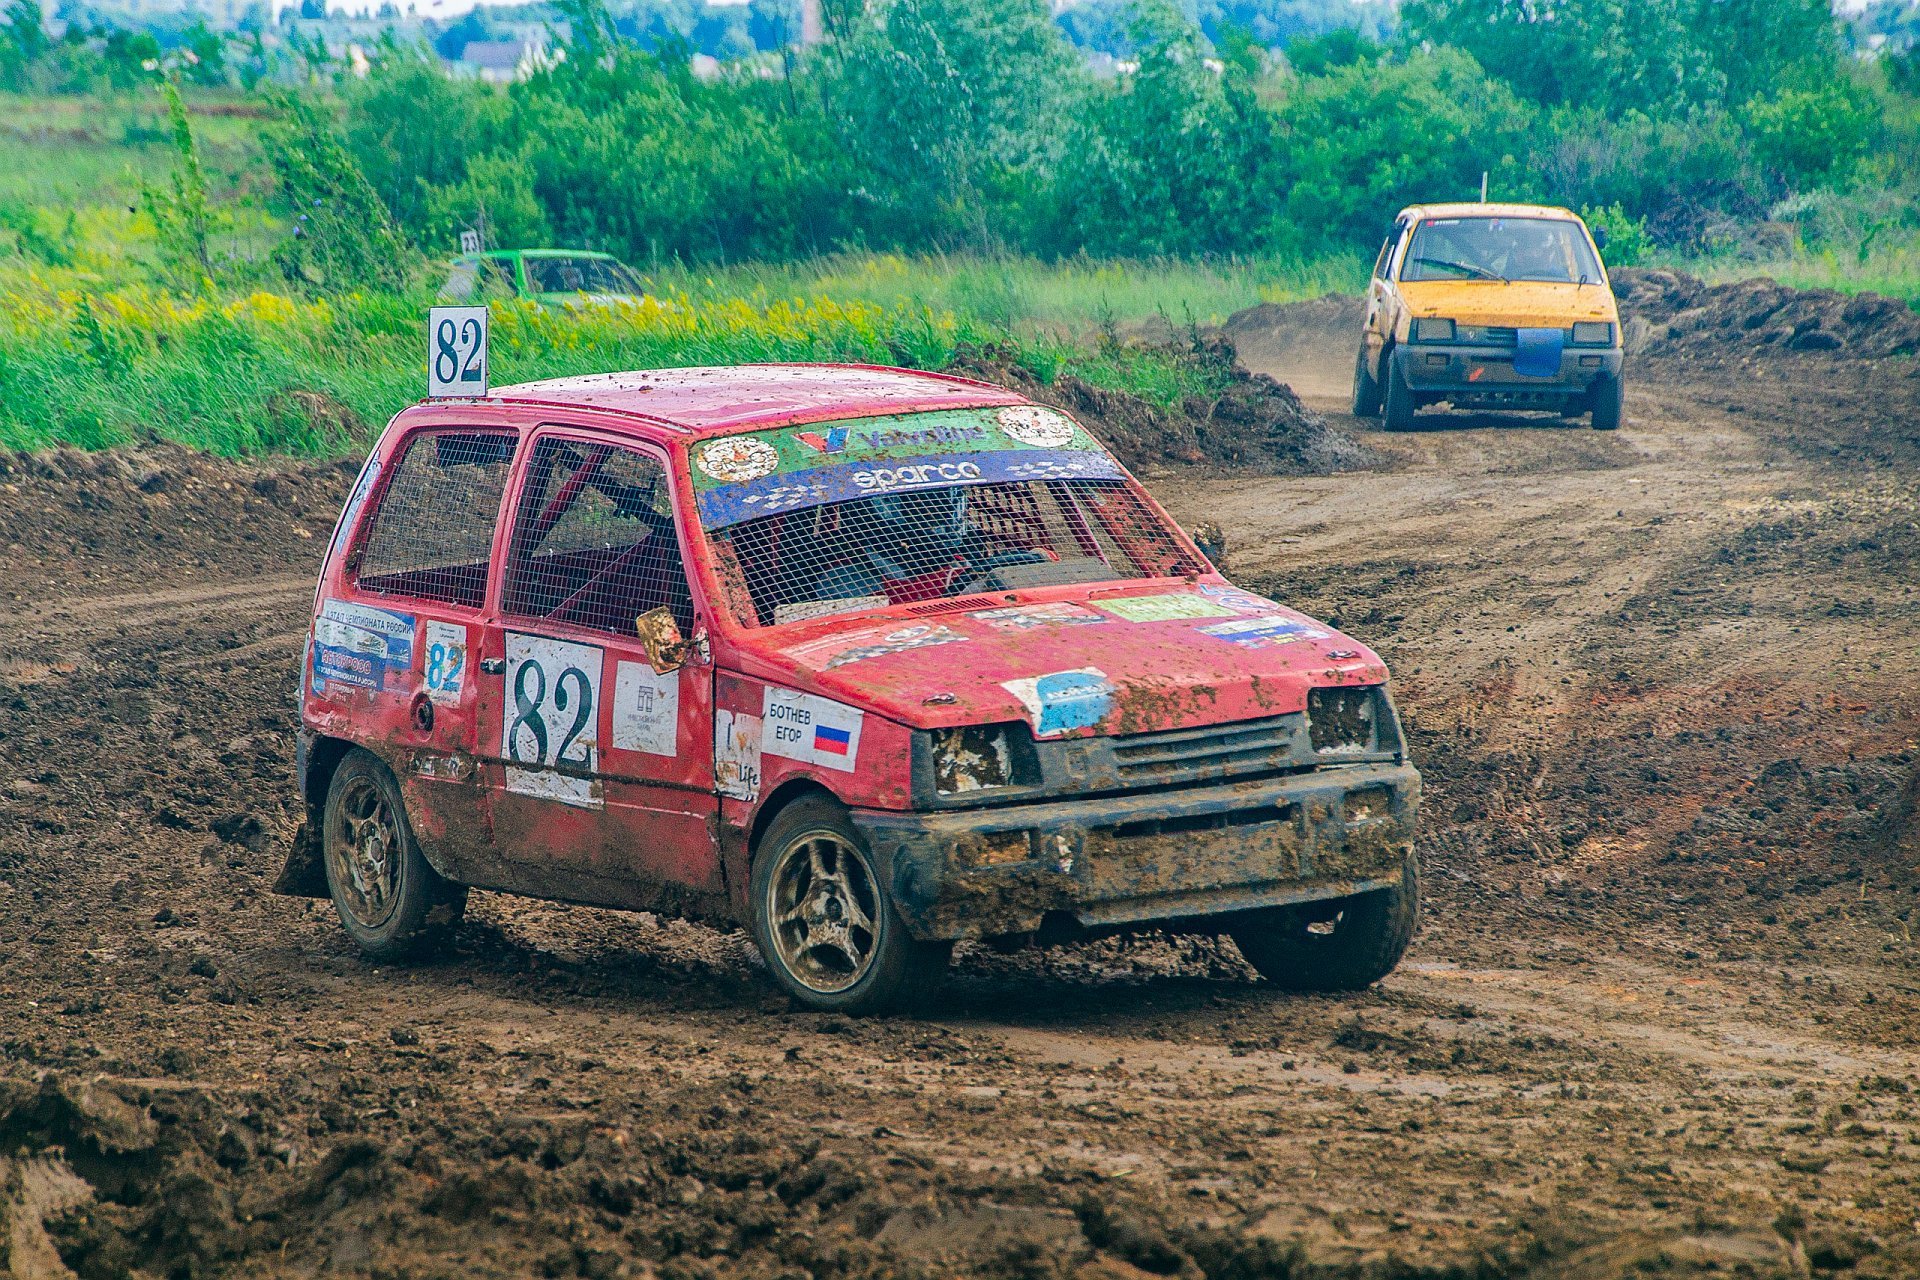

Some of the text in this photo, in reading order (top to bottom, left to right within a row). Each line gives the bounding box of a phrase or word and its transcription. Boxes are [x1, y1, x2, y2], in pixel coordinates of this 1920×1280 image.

[435, 318, 482, 384] 82
[852, 461, 982, 493] sparco
[345, 613, 385, 630] ЧЕМПИОНАТА
[386, 623, 413, 635] РОССИИ
[427, 643, 463, 692] 82
[508, 659, 592, 781] 82
[769, 703, 811, 725] БОТНЕВ
[776, 726, 802, 743] ЕГОР
